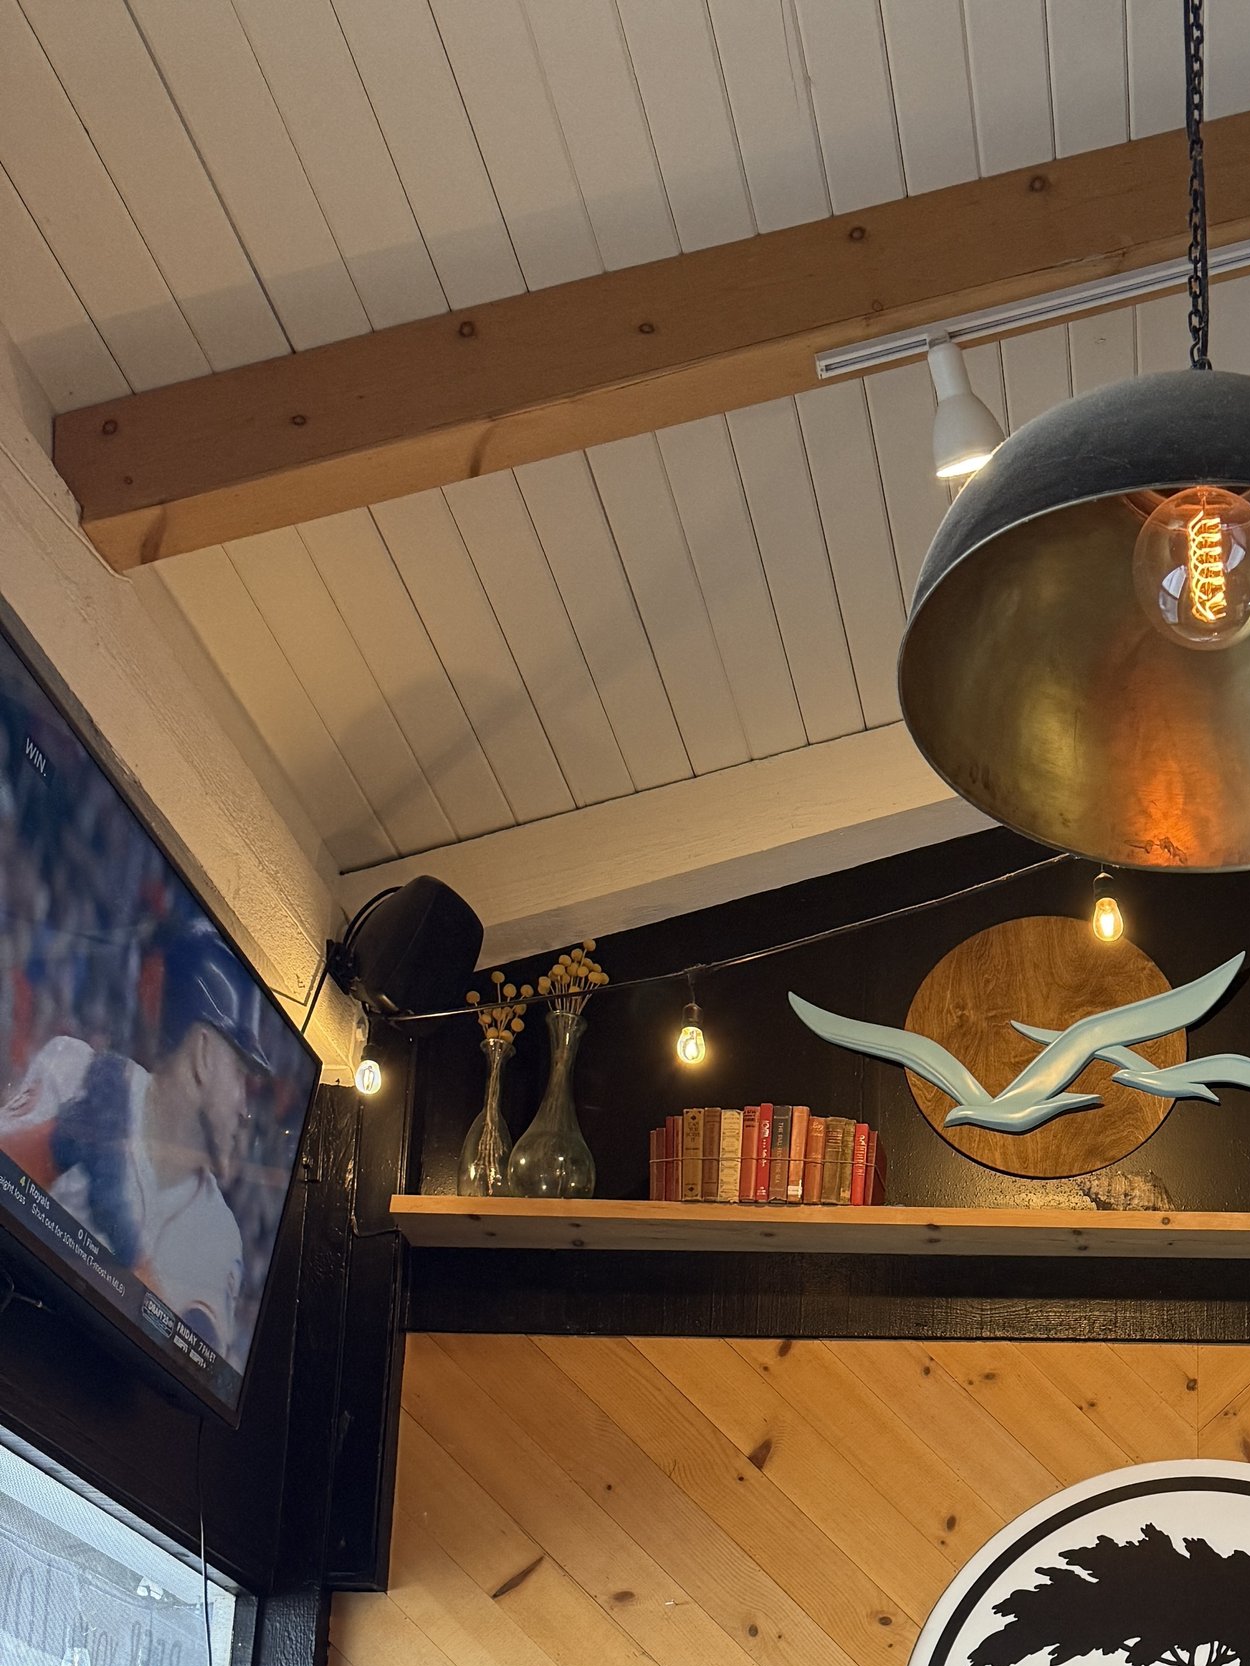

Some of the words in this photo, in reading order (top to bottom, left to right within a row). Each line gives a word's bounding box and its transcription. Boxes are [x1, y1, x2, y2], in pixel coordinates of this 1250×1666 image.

[25, 737, 47, 777] WIN.
[20, 1176, 26, 1187] 4
[30, 1183, 50, 1210] Royals
[31, 1203, 46, 1223] Shut
[45, 1218, 55, 1232] out
[54, 1224, 64, 1238] for
[86, 1238, 100, 1255] Final
[176, 1321, 198, 1346] FRIDAY
